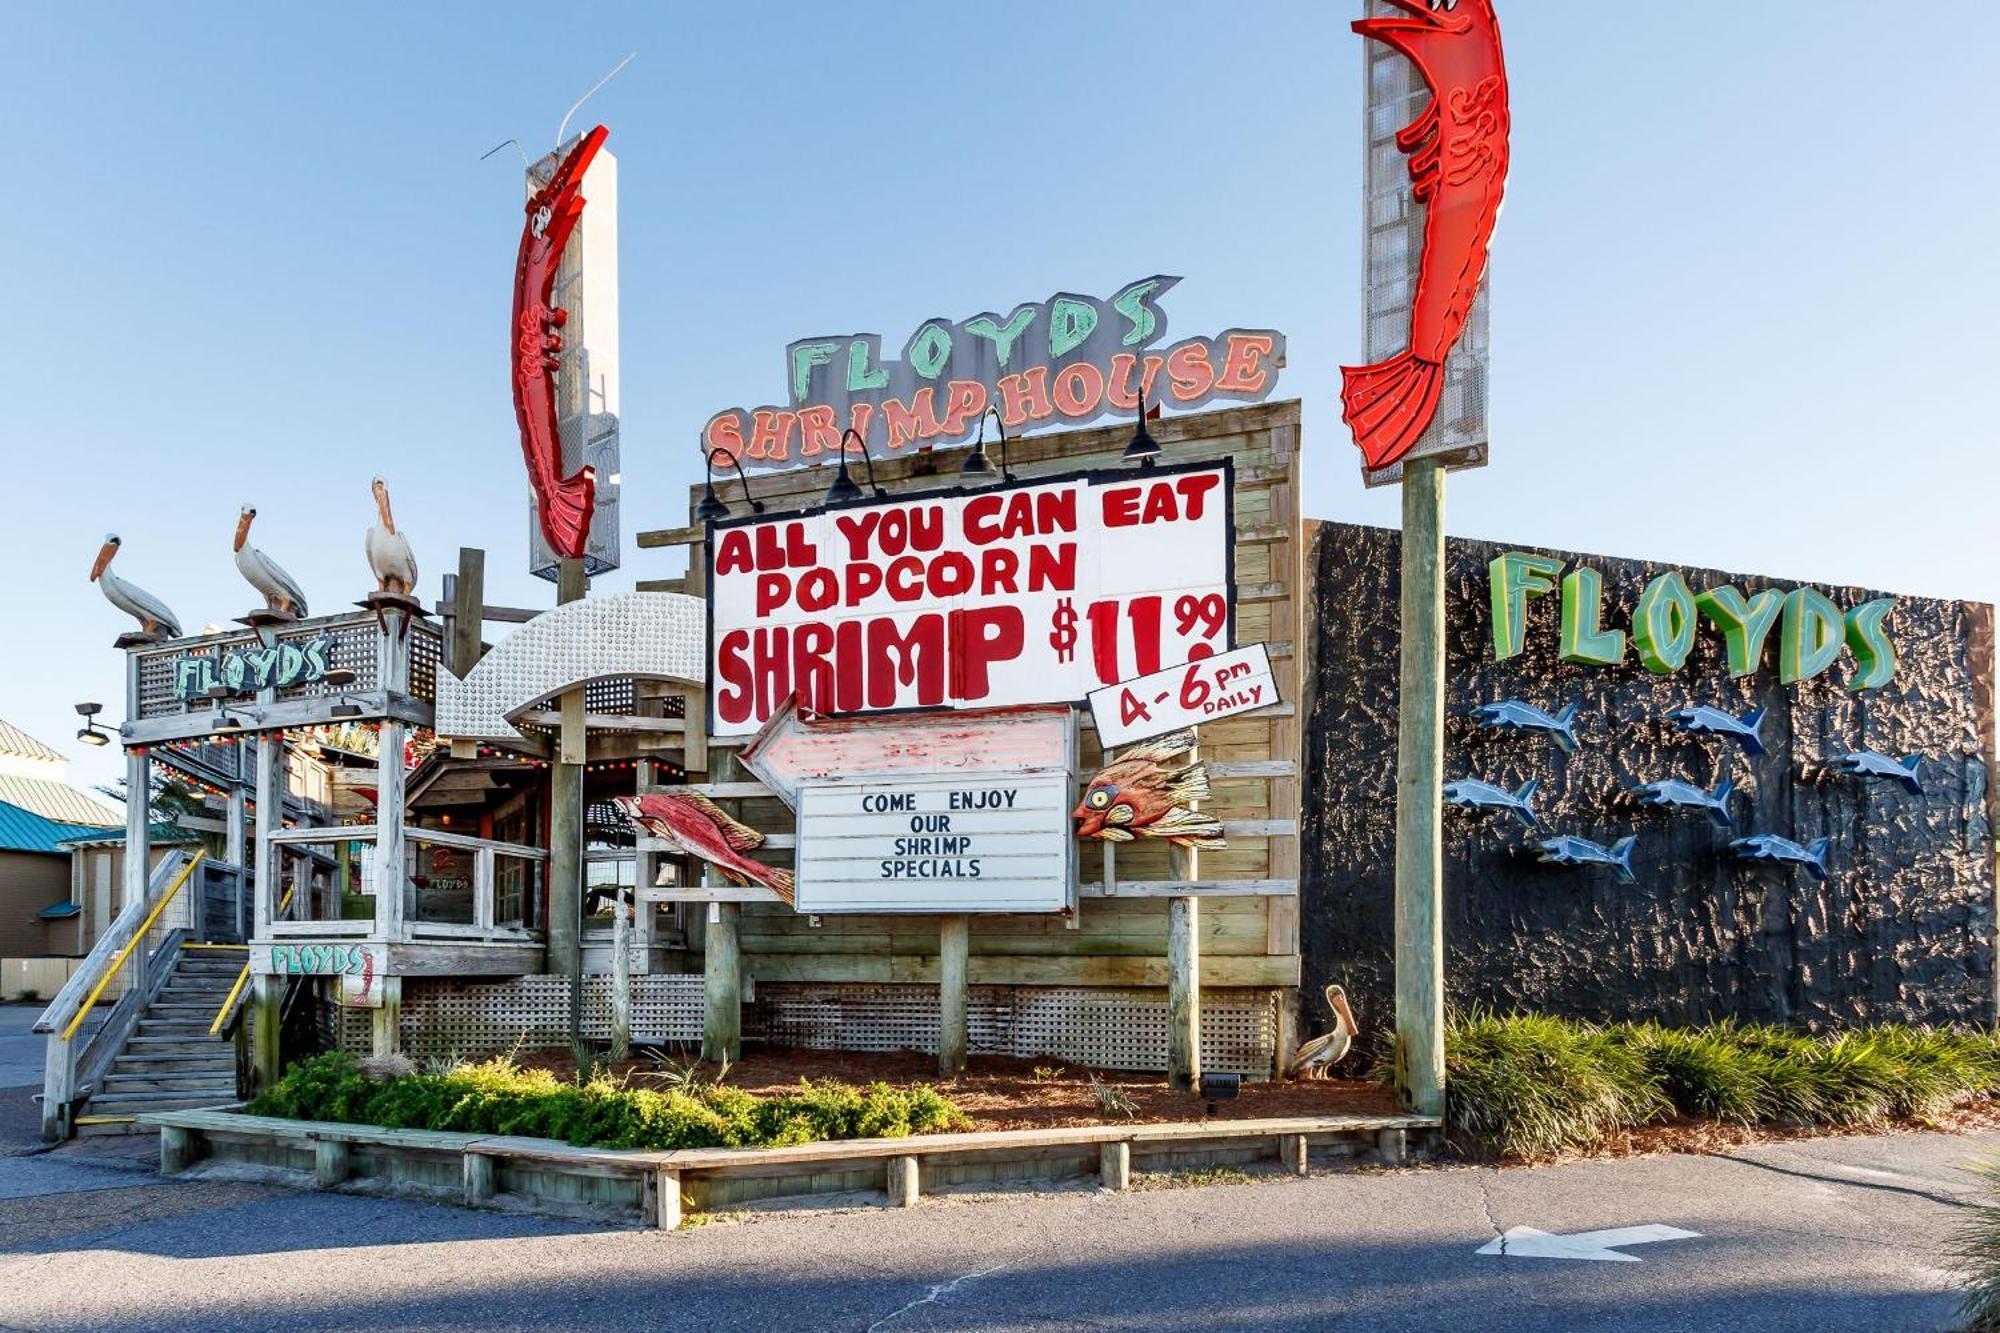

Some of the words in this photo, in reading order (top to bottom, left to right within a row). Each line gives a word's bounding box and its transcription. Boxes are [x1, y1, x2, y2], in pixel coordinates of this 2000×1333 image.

[793, 279, 1160, 402] FLOYDS
[716, 522, 816, 575] ALL
[837, 505, 943, 561] YOU
[963, 489, 1076, 545] CAN
[1103, 474, 1219, 528] EAT
[757, 543, 1076, 617] POPCORN
[1489, 551, 1900, 691] FLOYDS
[175, 638, 327, 700] FLOYDS
[718, 605, 1024, 723] SHRIMP
[1203, 685, 1262, 715] DAILY
[862, 793, 916, 813] COME
[949, 789, 1017, 810] ENJOY
[910, 815, 951, 833] OUR
[881, 859, 981, 878] SPECIALS
[894, 836, 971, 856] SHRIMP
[271, 943, 365, 975] FLOYDS
